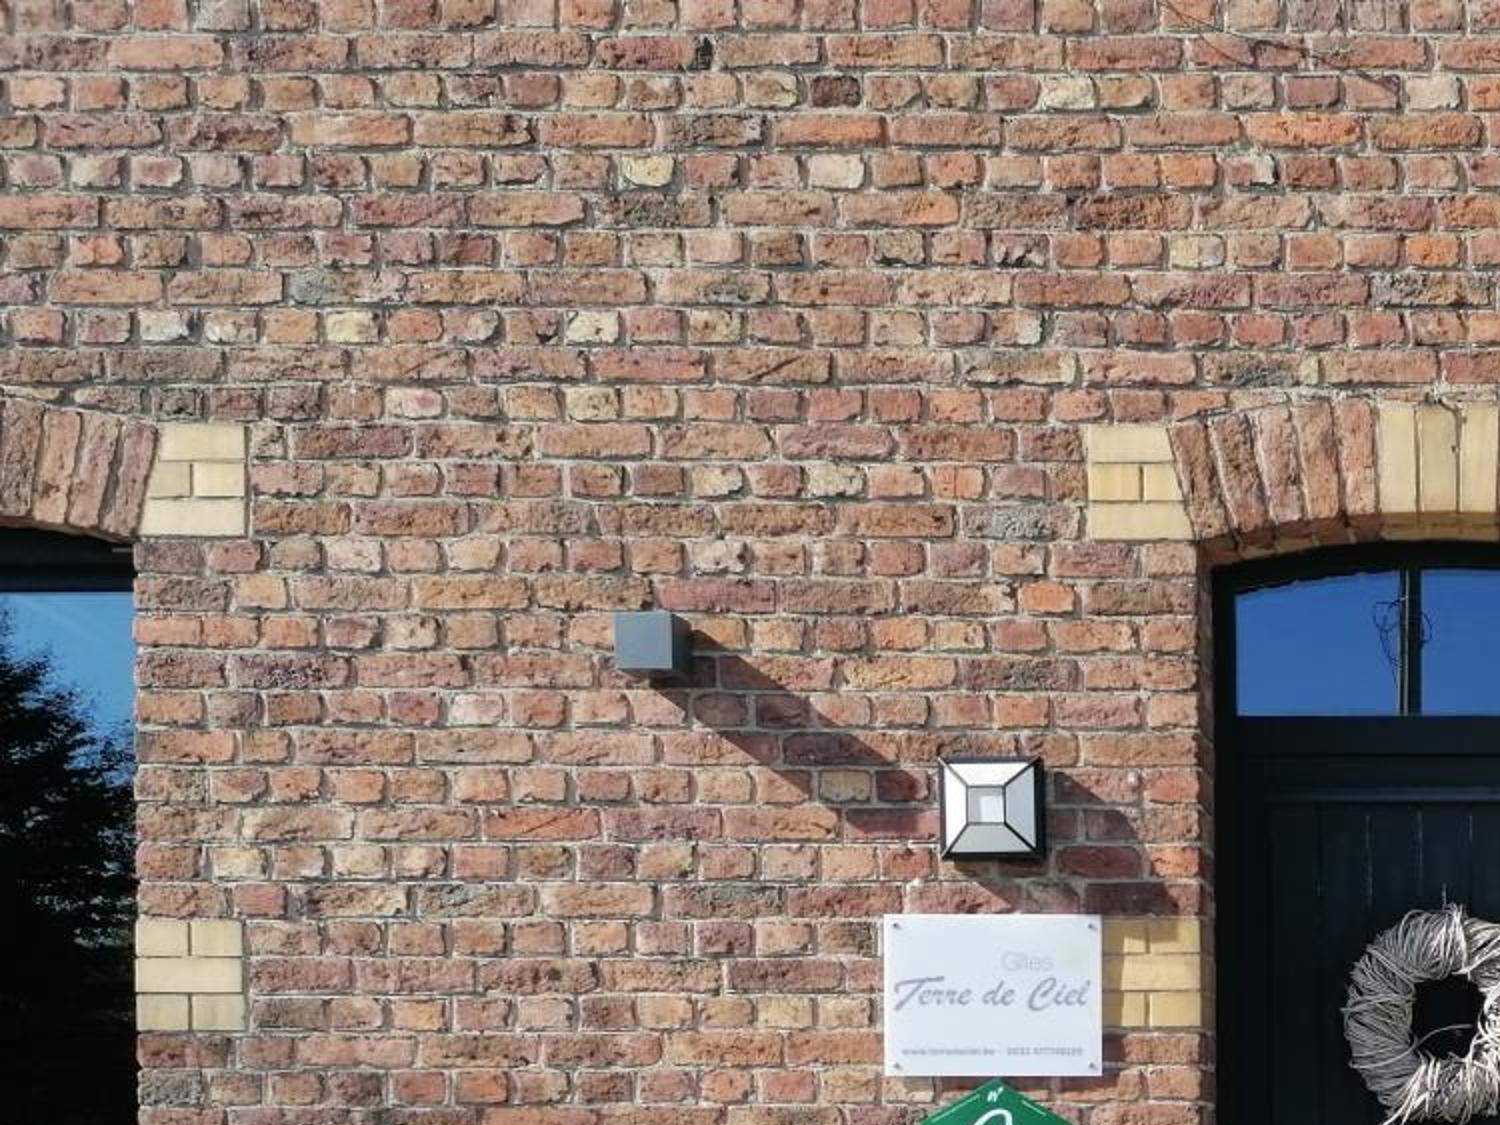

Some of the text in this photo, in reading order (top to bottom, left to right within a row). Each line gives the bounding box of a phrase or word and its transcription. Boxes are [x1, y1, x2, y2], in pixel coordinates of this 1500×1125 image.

[894, 976, 1091, 1012] Terre de Ciel
